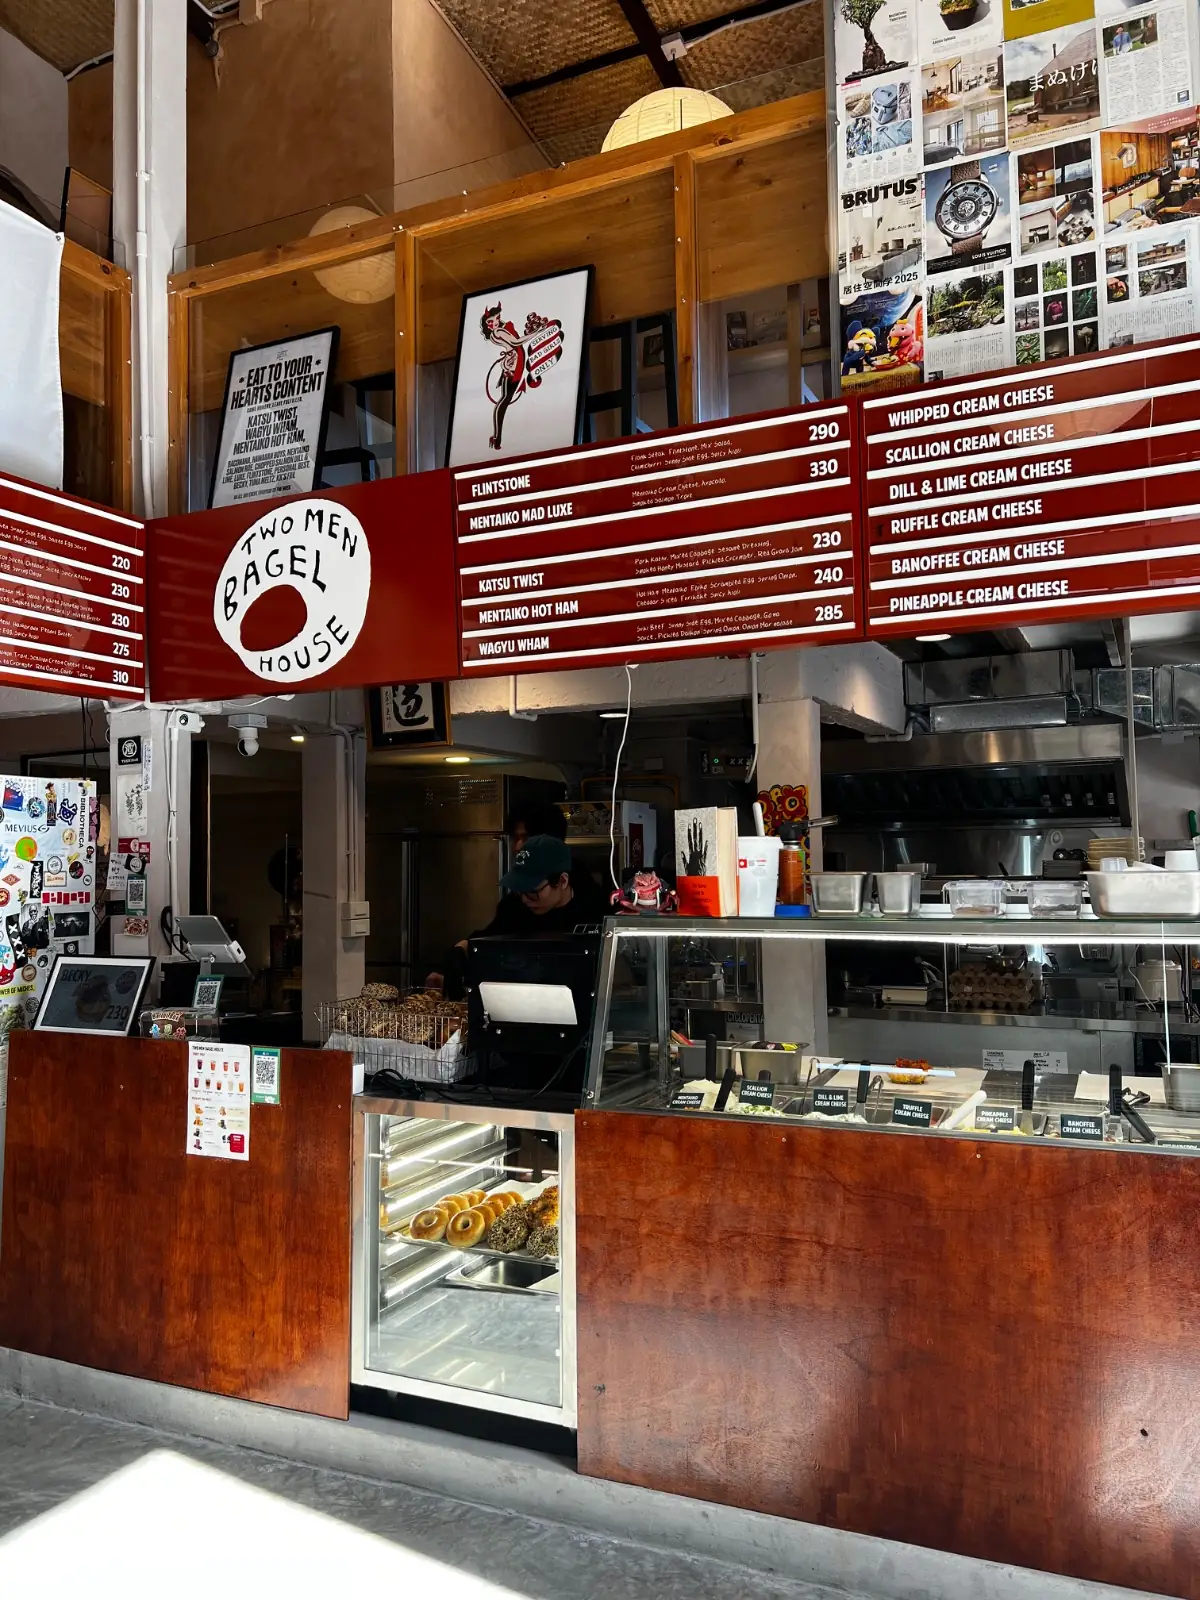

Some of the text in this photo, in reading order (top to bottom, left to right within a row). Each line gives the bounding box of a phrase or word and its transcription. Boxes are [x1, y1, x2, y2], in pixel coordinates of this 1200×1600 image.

[841, 178, 917, 210] BRUTUS
[894, 272, 918, 284] 2025
[532, 326, 557, 346] SERVING
[530, 350, 543, 363] BAD
[246, 355, 312, 387] EAT TO YOUR
[535, 358, 554, 376] ONLY
[231, 383, 272, 410] HEARTS
[273, 372, 324, 398] CONTENT
[888, 385, 1054, 427] WHIPPED CREAM CHEESE
[248, 411, 271, 428] KATSU
[246, 424, 272, 440] WAGYU
[809, 422, 839, 441] 290
[233, 436, 270, 455] MENTAIKO
[270, 434, 287, 447] HOT
[886, 424, 1054, 464] SCALLION CREAM CHEESE
[810, 459, 838, 477] 330
[472, 475, 530, 497] FLINTSTONE
[889, 458, 1072, 500] DILL & LIME CREAM CHEESE
[470, 503, 572, 530] MENTAIKO MAD LUXE
[942, 506, 988, 527] CREAM
[992, 499, 1042, 520] CHEESE
[241, 508, 358, 557] TWO MEN
[812, 531, 842, 548] 230
[111, 554, 130, 570] 220
[892, 540, 1065, 574] BANOFFEE CREAM CHEESE
[224, 545, 326, 621] BAGEL
[479, 573, 544, 592] KATSU TWIST
[814, 567, 843, 584] 240
[111, 582, 130, 598] 230
[890, 580, 1068, 612] PINEAPPLE CREAM CHEESE
[111, 613, 130, 628] 230
[479, 600, 578, 624] MENTAIKO HOT HAM
[814, 605, 843, 621] 285
[112, 642, 129, 656] 275
[260, 615, 350, 672] HOUSE
[479, 636, 550, 655] WAGYU WHAM
[112, 670, 128, 684] 310
[5, 824, 37, 832] MEVIUS
[60, 969, 92, 982] BECKY
[107, 1004, 130, 1020] 230
